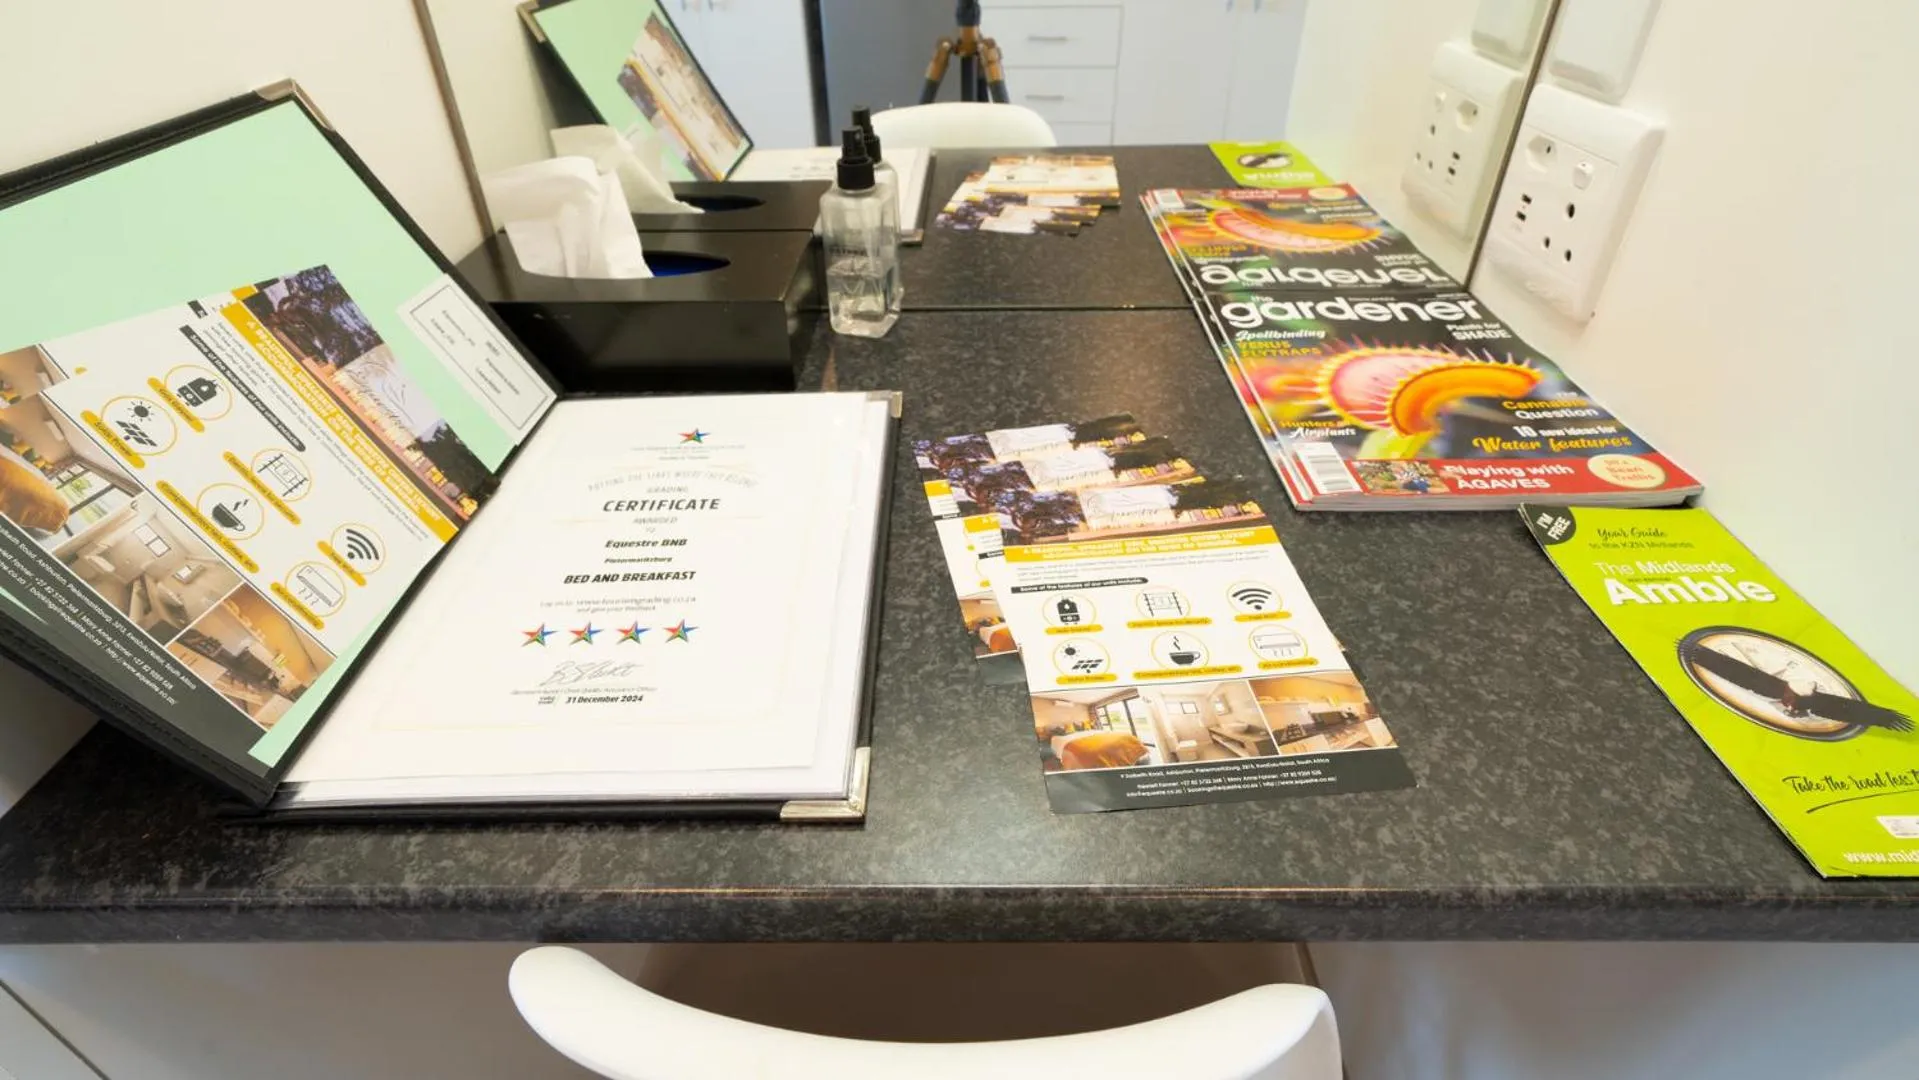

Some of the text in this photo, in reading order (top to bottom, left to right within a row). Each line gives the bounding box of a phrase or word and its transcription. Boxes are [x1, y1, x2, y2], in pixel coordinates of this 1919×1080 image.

[1220, 296, 1482, 328] gardener
[1235, 329, 1326, 340] Spellbinding
[1452, 329, 1513, 340] SHADE
[1236, 340, 1292, 349] VENUS
[1502, 400, 1588, 410] Cannabis
[1515, 408, 1599, 420] Question
[1513, 425, 1539, 438] 10
[1472, 436, 1633, 454] Water features
[1442, 464, 1575, 478] Playing with
[1458, 478, 1551, 490] AGAVES
[602, 498, 722, 513] CERTIFICATE
[1547, 516, 1572, 541] FREE
[604, 538, 688, 550] Equestre BNB
[1594, 560, 1736, 576] The Midlands
[564, 571, 697, 584] BED AND BREAKFAST
[1604, 576, 1777, 606] Amble
[565, 696, 578, 704] 31
[577, 696, 620, 704] December
[620, 695, 644, 703] 2024
[1782, 776, 1826, 794] Take
[1823, 775, 1850, 792] the
[1847, 772, 1887, 790] road
